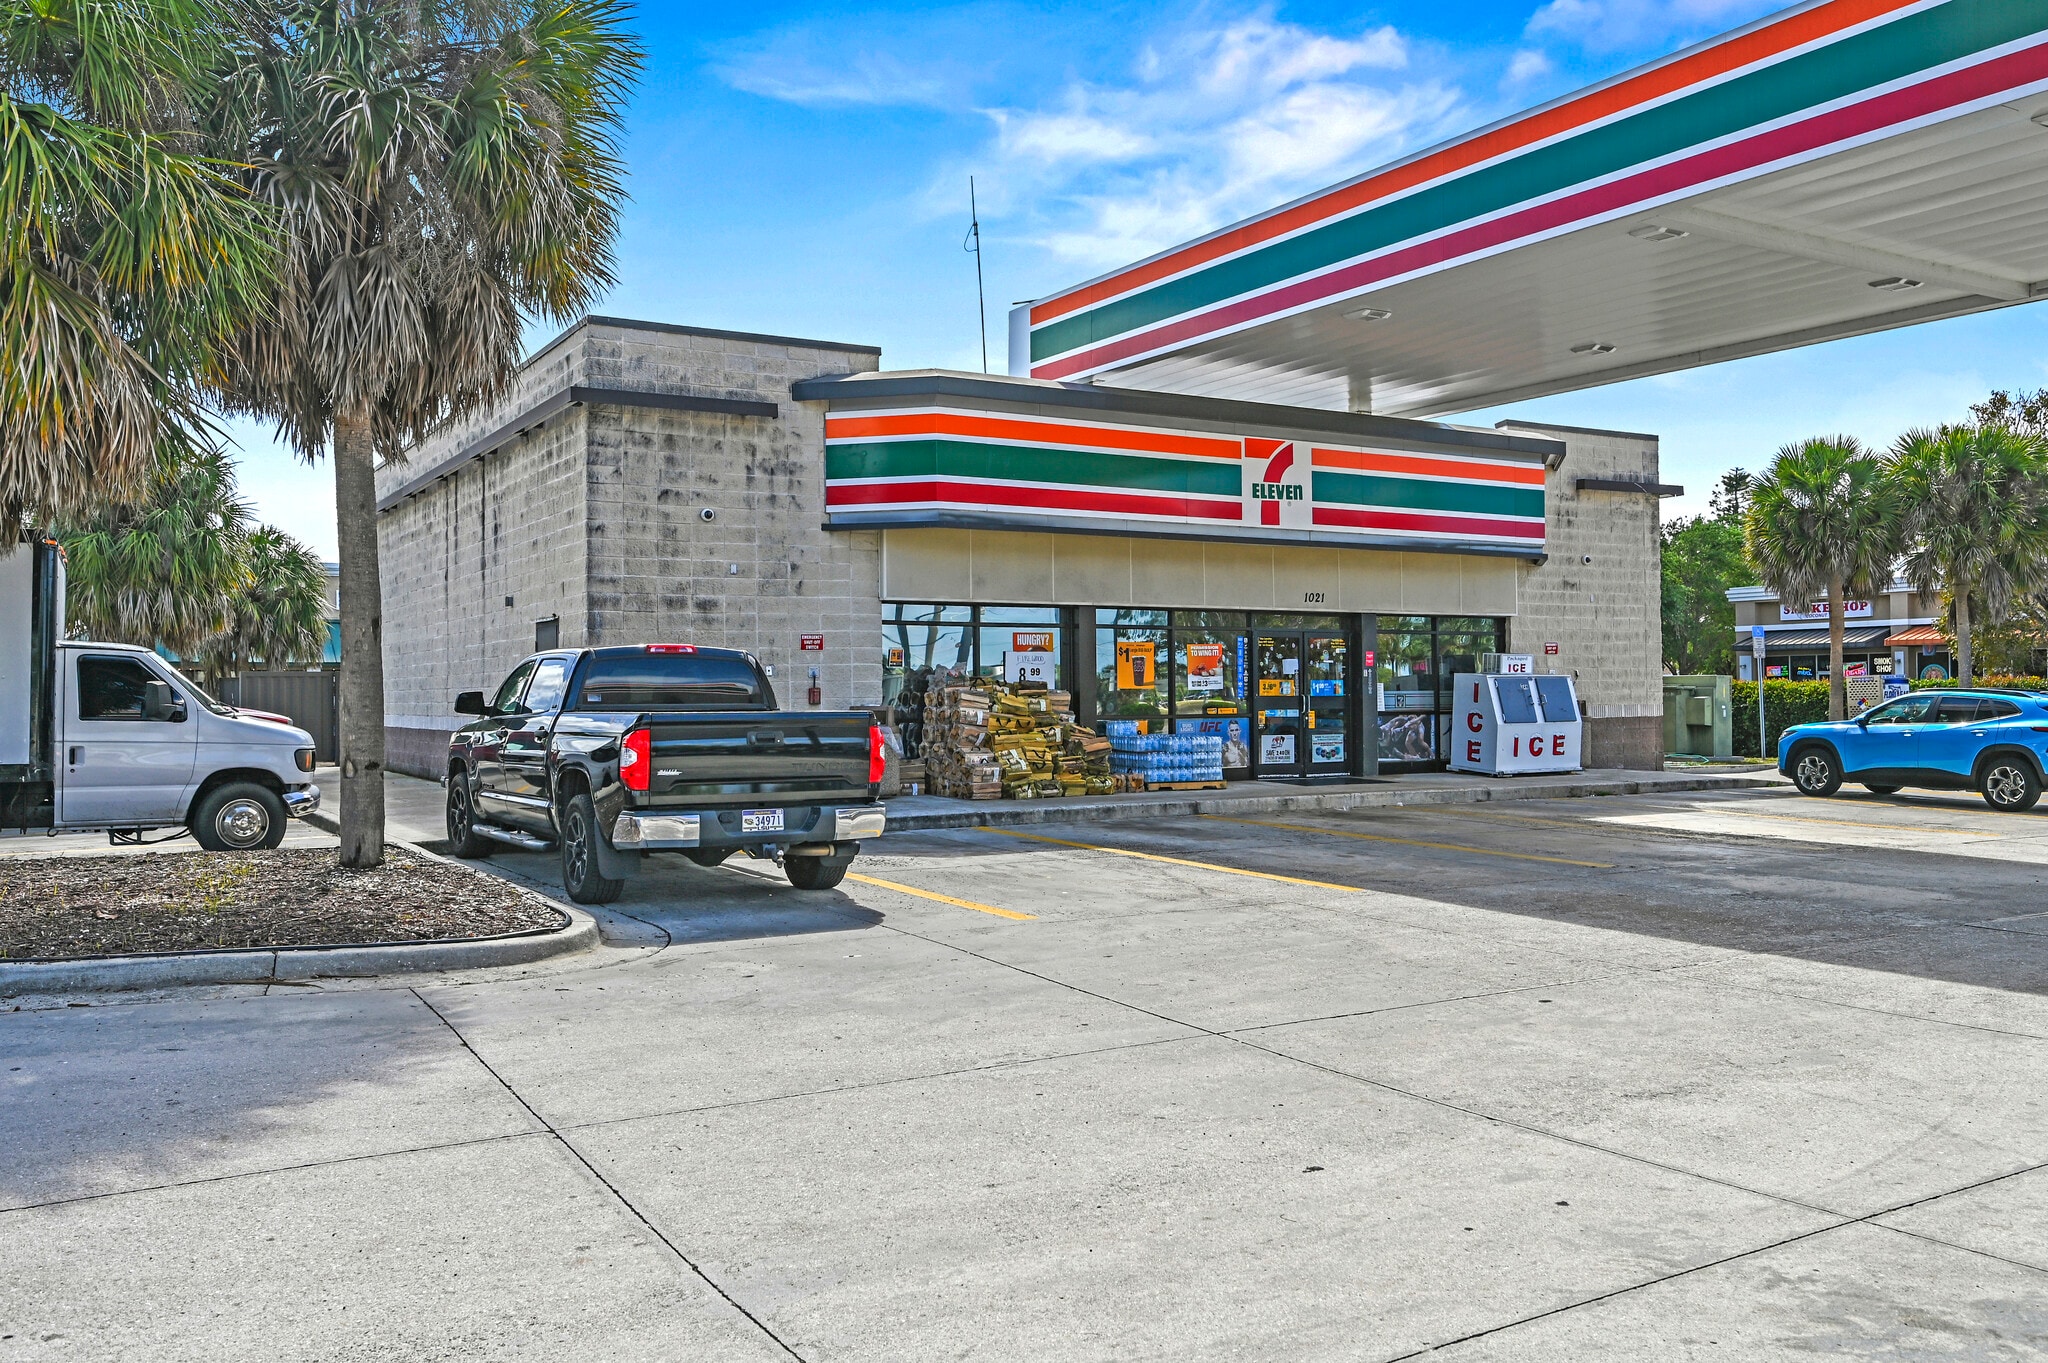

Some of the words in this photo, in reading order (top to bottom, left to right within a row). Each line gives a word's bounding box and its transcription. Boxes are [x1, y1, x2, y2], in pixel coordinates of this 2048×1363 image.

[1245, 438, 1294, 525] 7
[1304, 592, 1325, 603] 1021
[1844, 601, 1868, 611] HOP
[1017, 634, 1049, 646] HUNGRY?
[1874, 657, 1891, 665] SMOK
[1508, 663, 1526, 672] ICE
[1019, 667, 1026, 680] 8
[1030, 668, 1040, 676] 99
[1200, 722, 1222, 732] UFC
[1467, 683, 1483, 763] ICE
[1513, 735, 1565, 757] ICE
[755, 815, 780, 826] 34971
